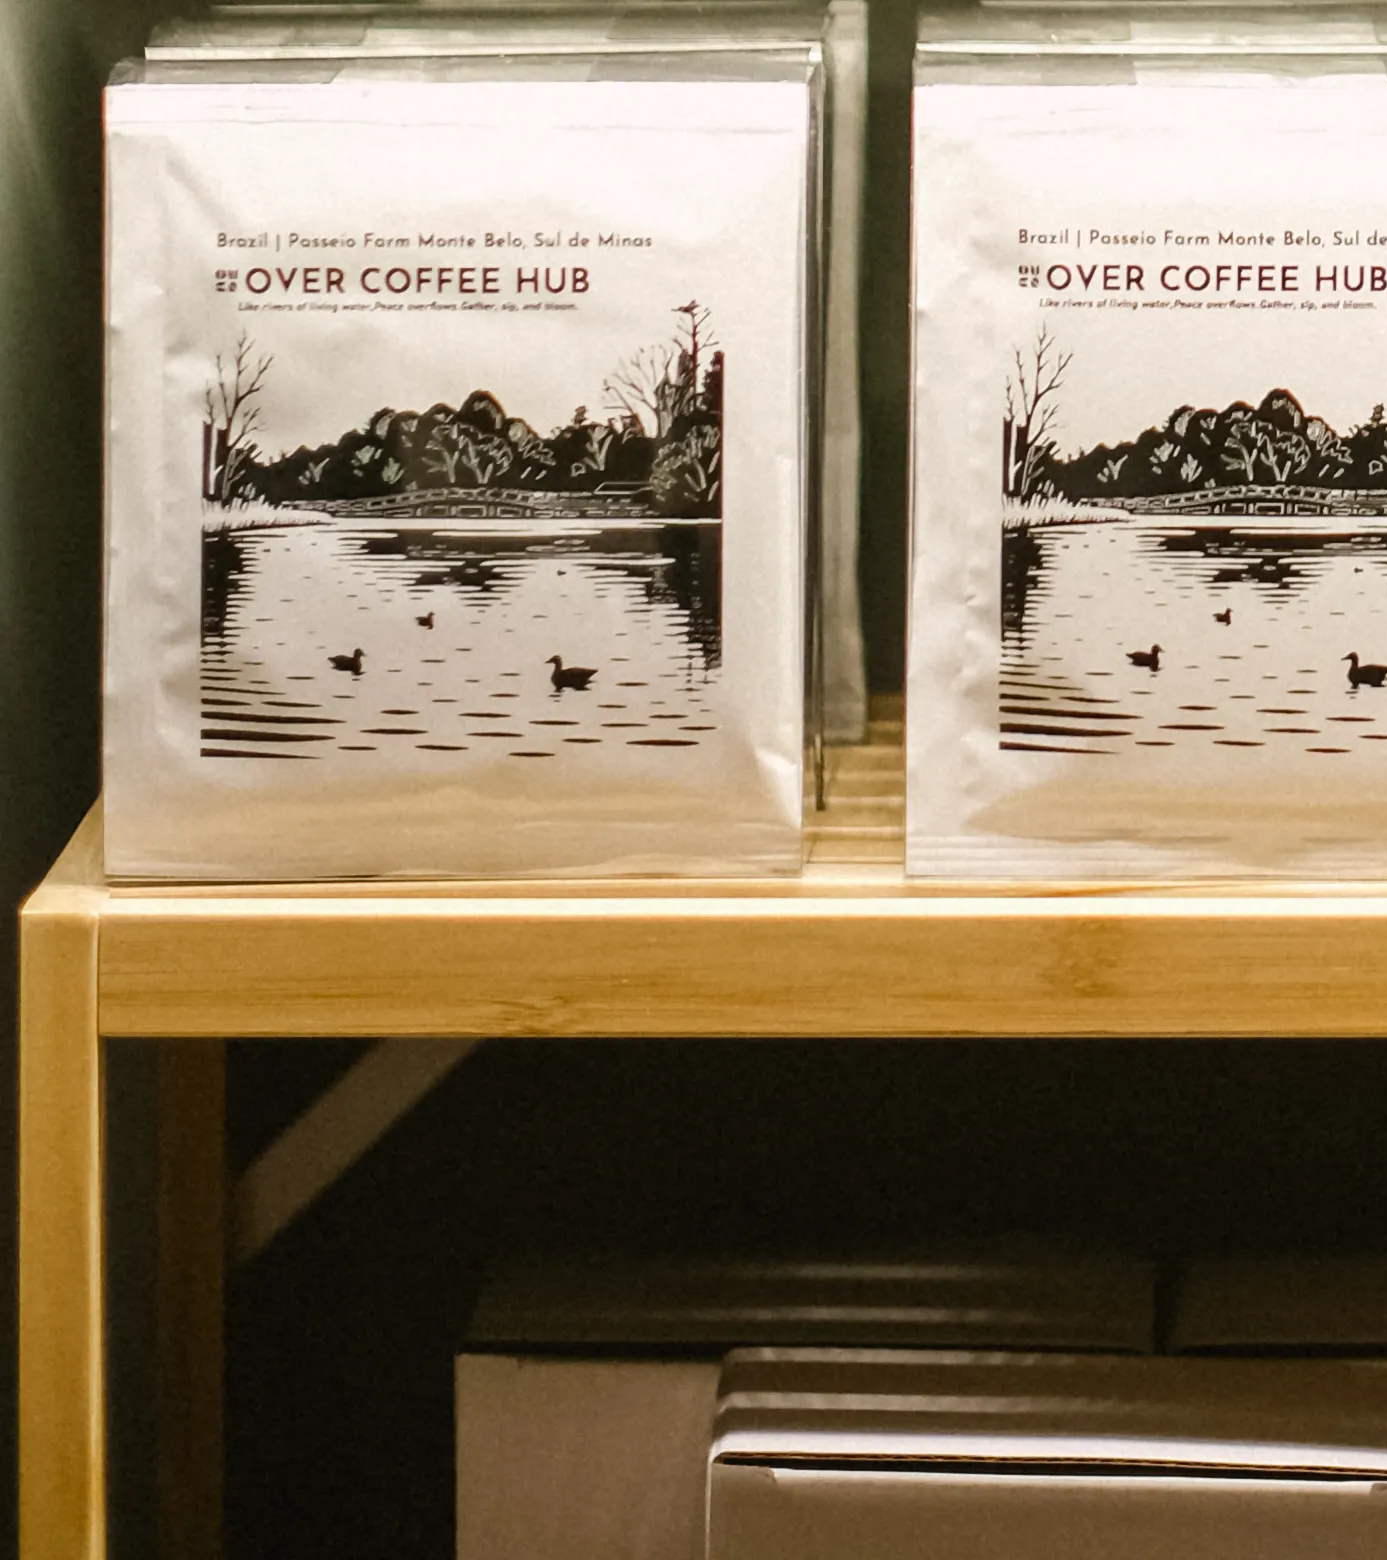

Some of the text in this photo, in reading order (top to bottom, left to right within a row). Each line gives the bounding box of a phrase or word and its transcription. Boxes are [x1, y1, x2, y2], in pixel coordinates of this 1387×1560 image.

[216, 231, 269, 249] Brazil
[288, 232, 357, 249] Passeio
[363, 231, 411, 249] Farm
[417, 233, 477, 249] Monte
[483, 231, 527, 251] Belo,
[533, 231, 561, 248] Sul
[567, 231, 591, 248] de
[597, 231, 653, 248] Minas
[1018, 228, 1069, 245] Brazil
[1089, 228, 1157, 246] Passeio
[1163, 229, 1210, 246] Farm
[1217, 230, 1276, 247] Monte
[1283, 228, 1325, 249] Belo,
[1332, 229, 1360, 247] Sul
[244, 266, 346, 295] OVER
[358, 266, 502, 295] COFFEE
[515, 266, 590, 295] HUB
[1046, 263, 1146, 292] OVER
[1159, 264, 1300, 292] COFFEE
[1039, 297, 1061, 309] Like
[1096, 298, 1108, 309] of
[1320, 299, 1341, 310] and
